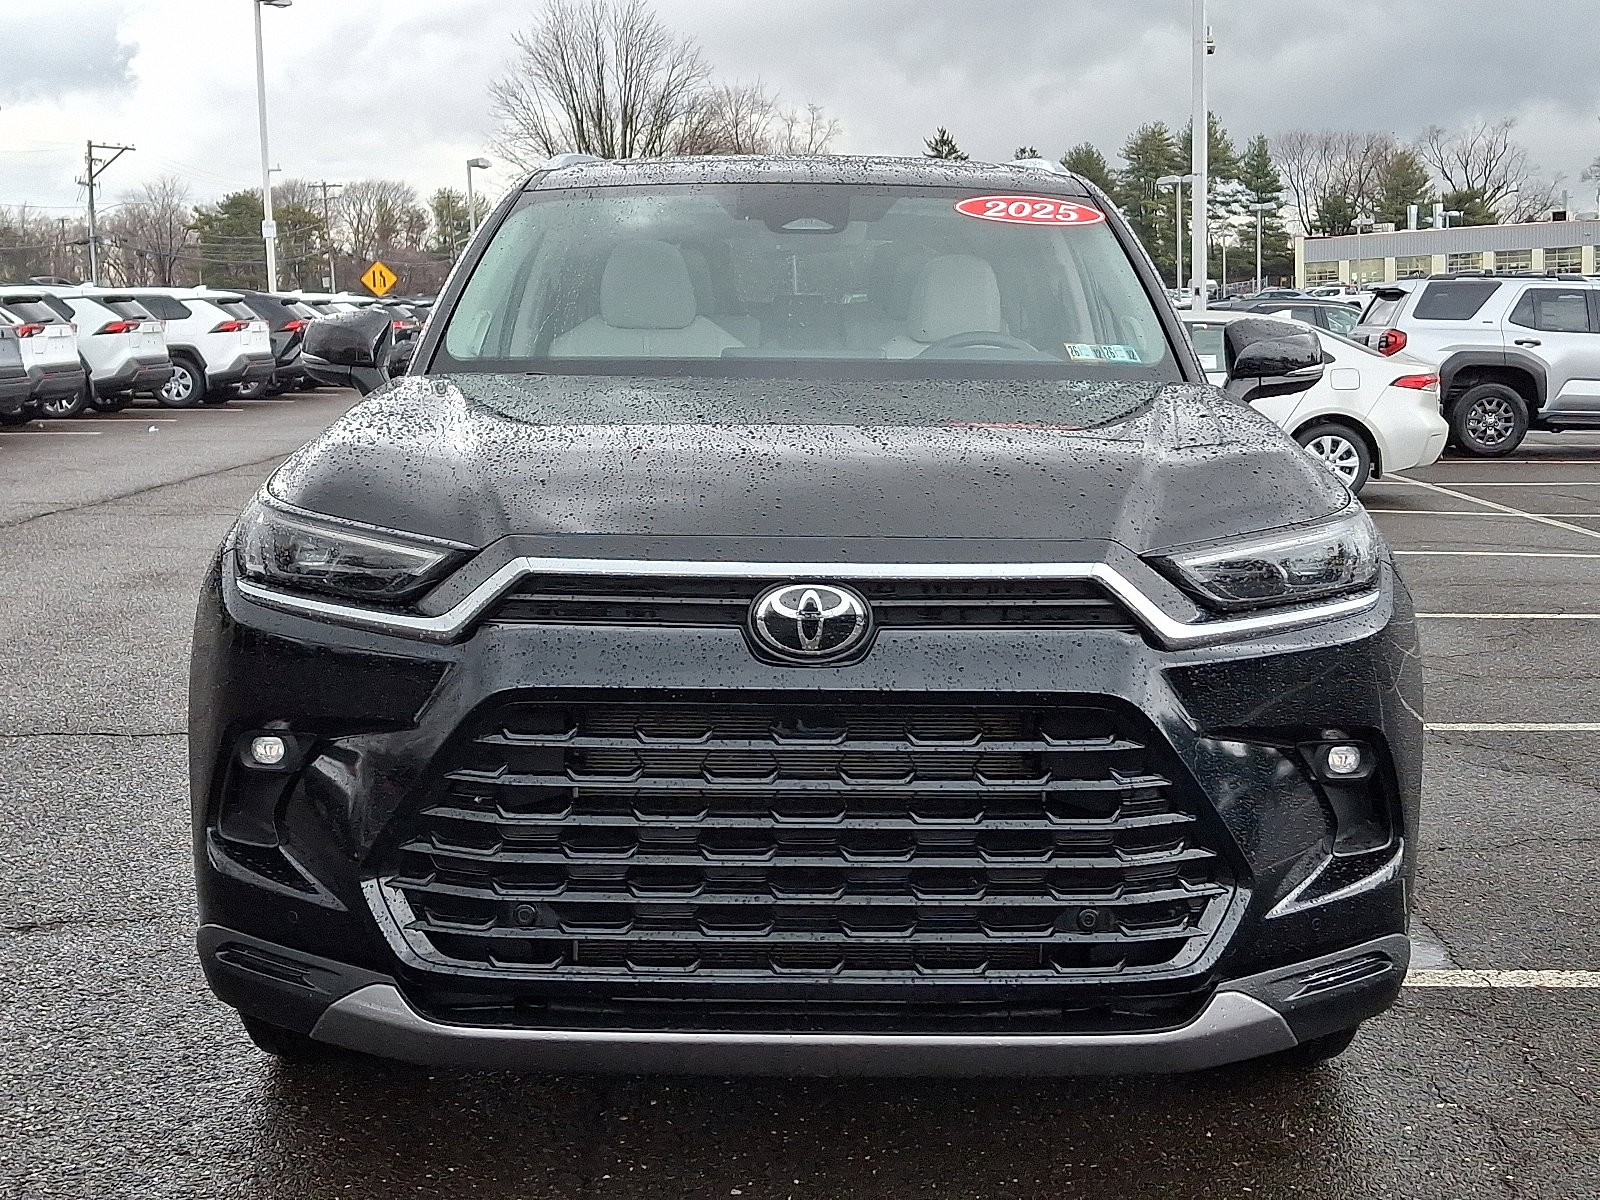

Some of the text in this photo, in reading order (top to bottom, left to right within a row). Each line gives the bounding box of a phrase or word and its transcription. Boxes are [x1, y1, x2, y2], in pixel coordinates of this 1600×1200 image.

[983, 201, 1078, 221] 2025
[1067, 345, 1080, 357] 26
[1103, 346, 1116, 359] 26
